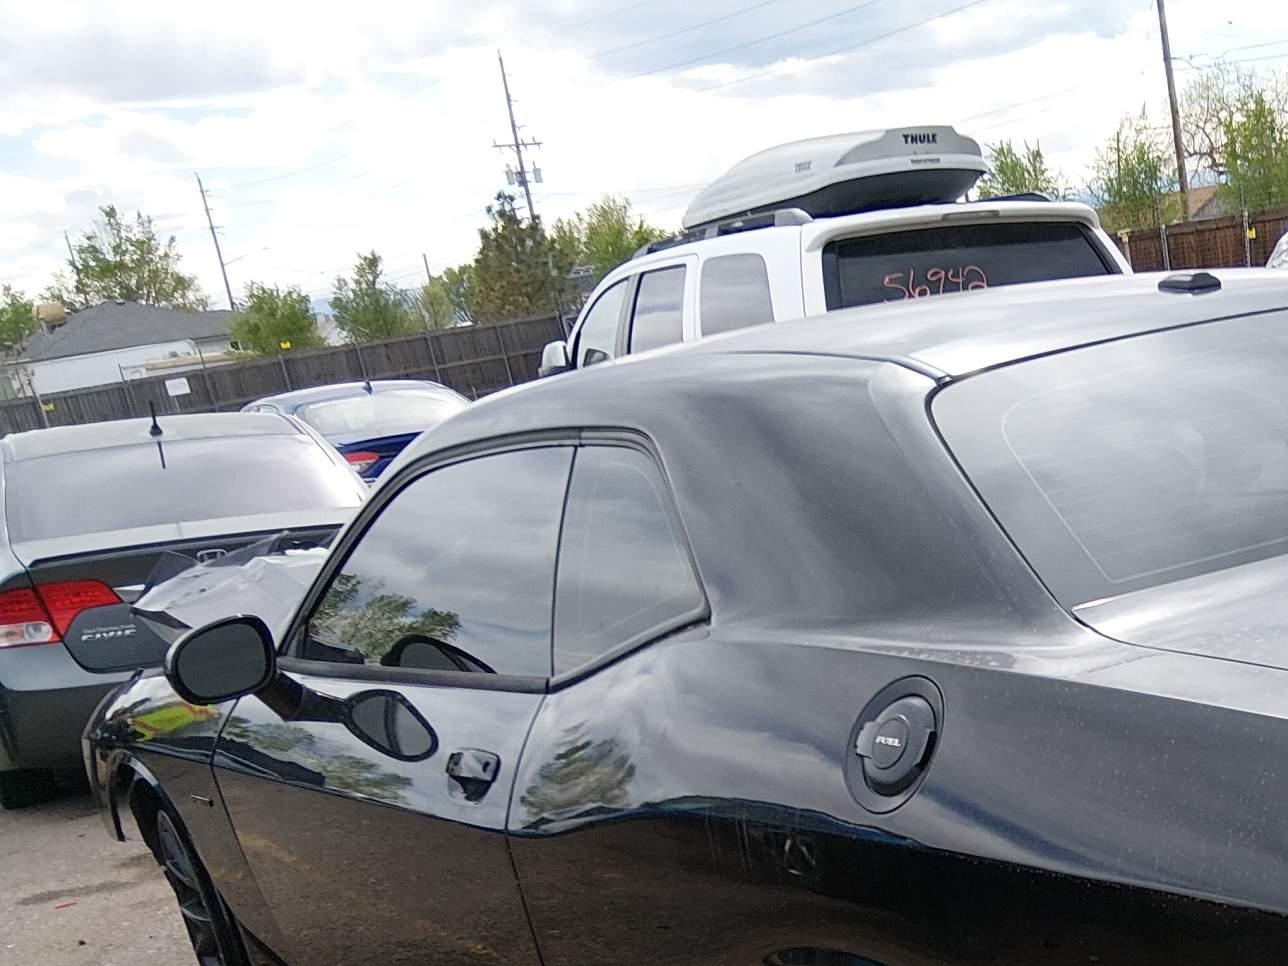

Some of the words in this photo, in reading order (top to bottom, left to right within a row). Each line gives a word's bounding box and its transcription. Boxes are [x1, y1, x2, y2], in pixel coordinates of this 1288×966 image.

[902, 132, 938, 145] THULE
[883, 264, 989, 304] 56942
[874, 735, 902, 748] FUEL
